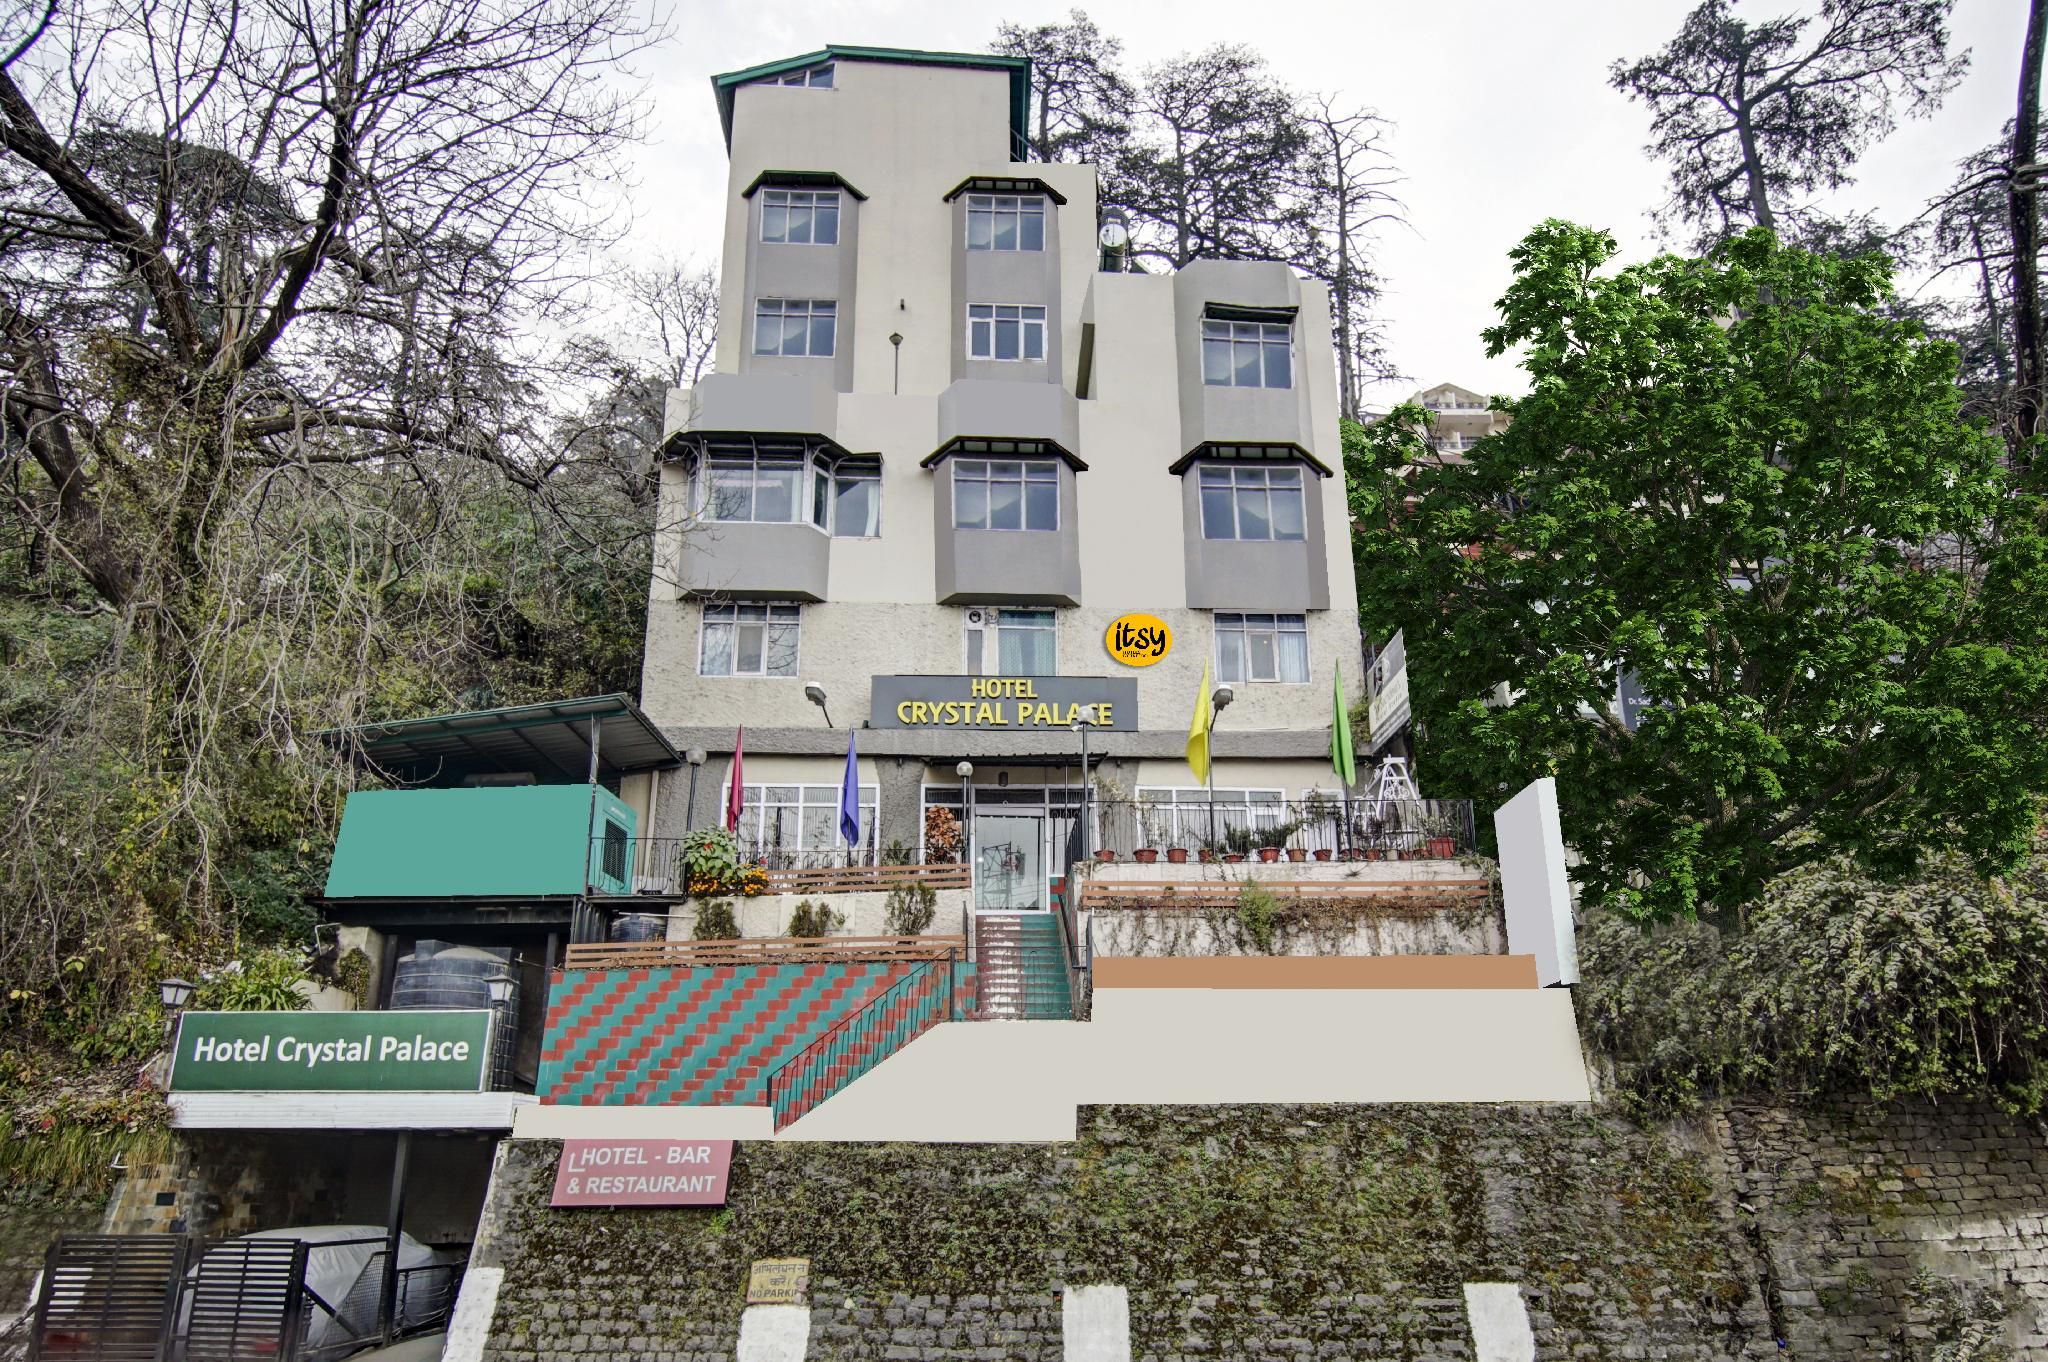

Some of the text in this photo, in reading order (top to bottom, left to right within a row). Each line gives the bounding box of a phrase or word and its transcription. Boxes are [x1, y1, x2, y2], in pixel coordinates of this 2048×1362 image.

[1116, 622, 1165, 656] itsy
[971, 679, 1038, 699] HOTEL
[897, 702, 1009, 725] CRYSTAL
[194, 1035, 469, 1067] Hotel Crystal Palace
[581, 1147, 648, 1166] HOTEL
[667, 1146, 711, 1164] BAR
[567, 1176, 716, 1194] & RESTAURANT
[750, 1290, 762, 1298] NO
